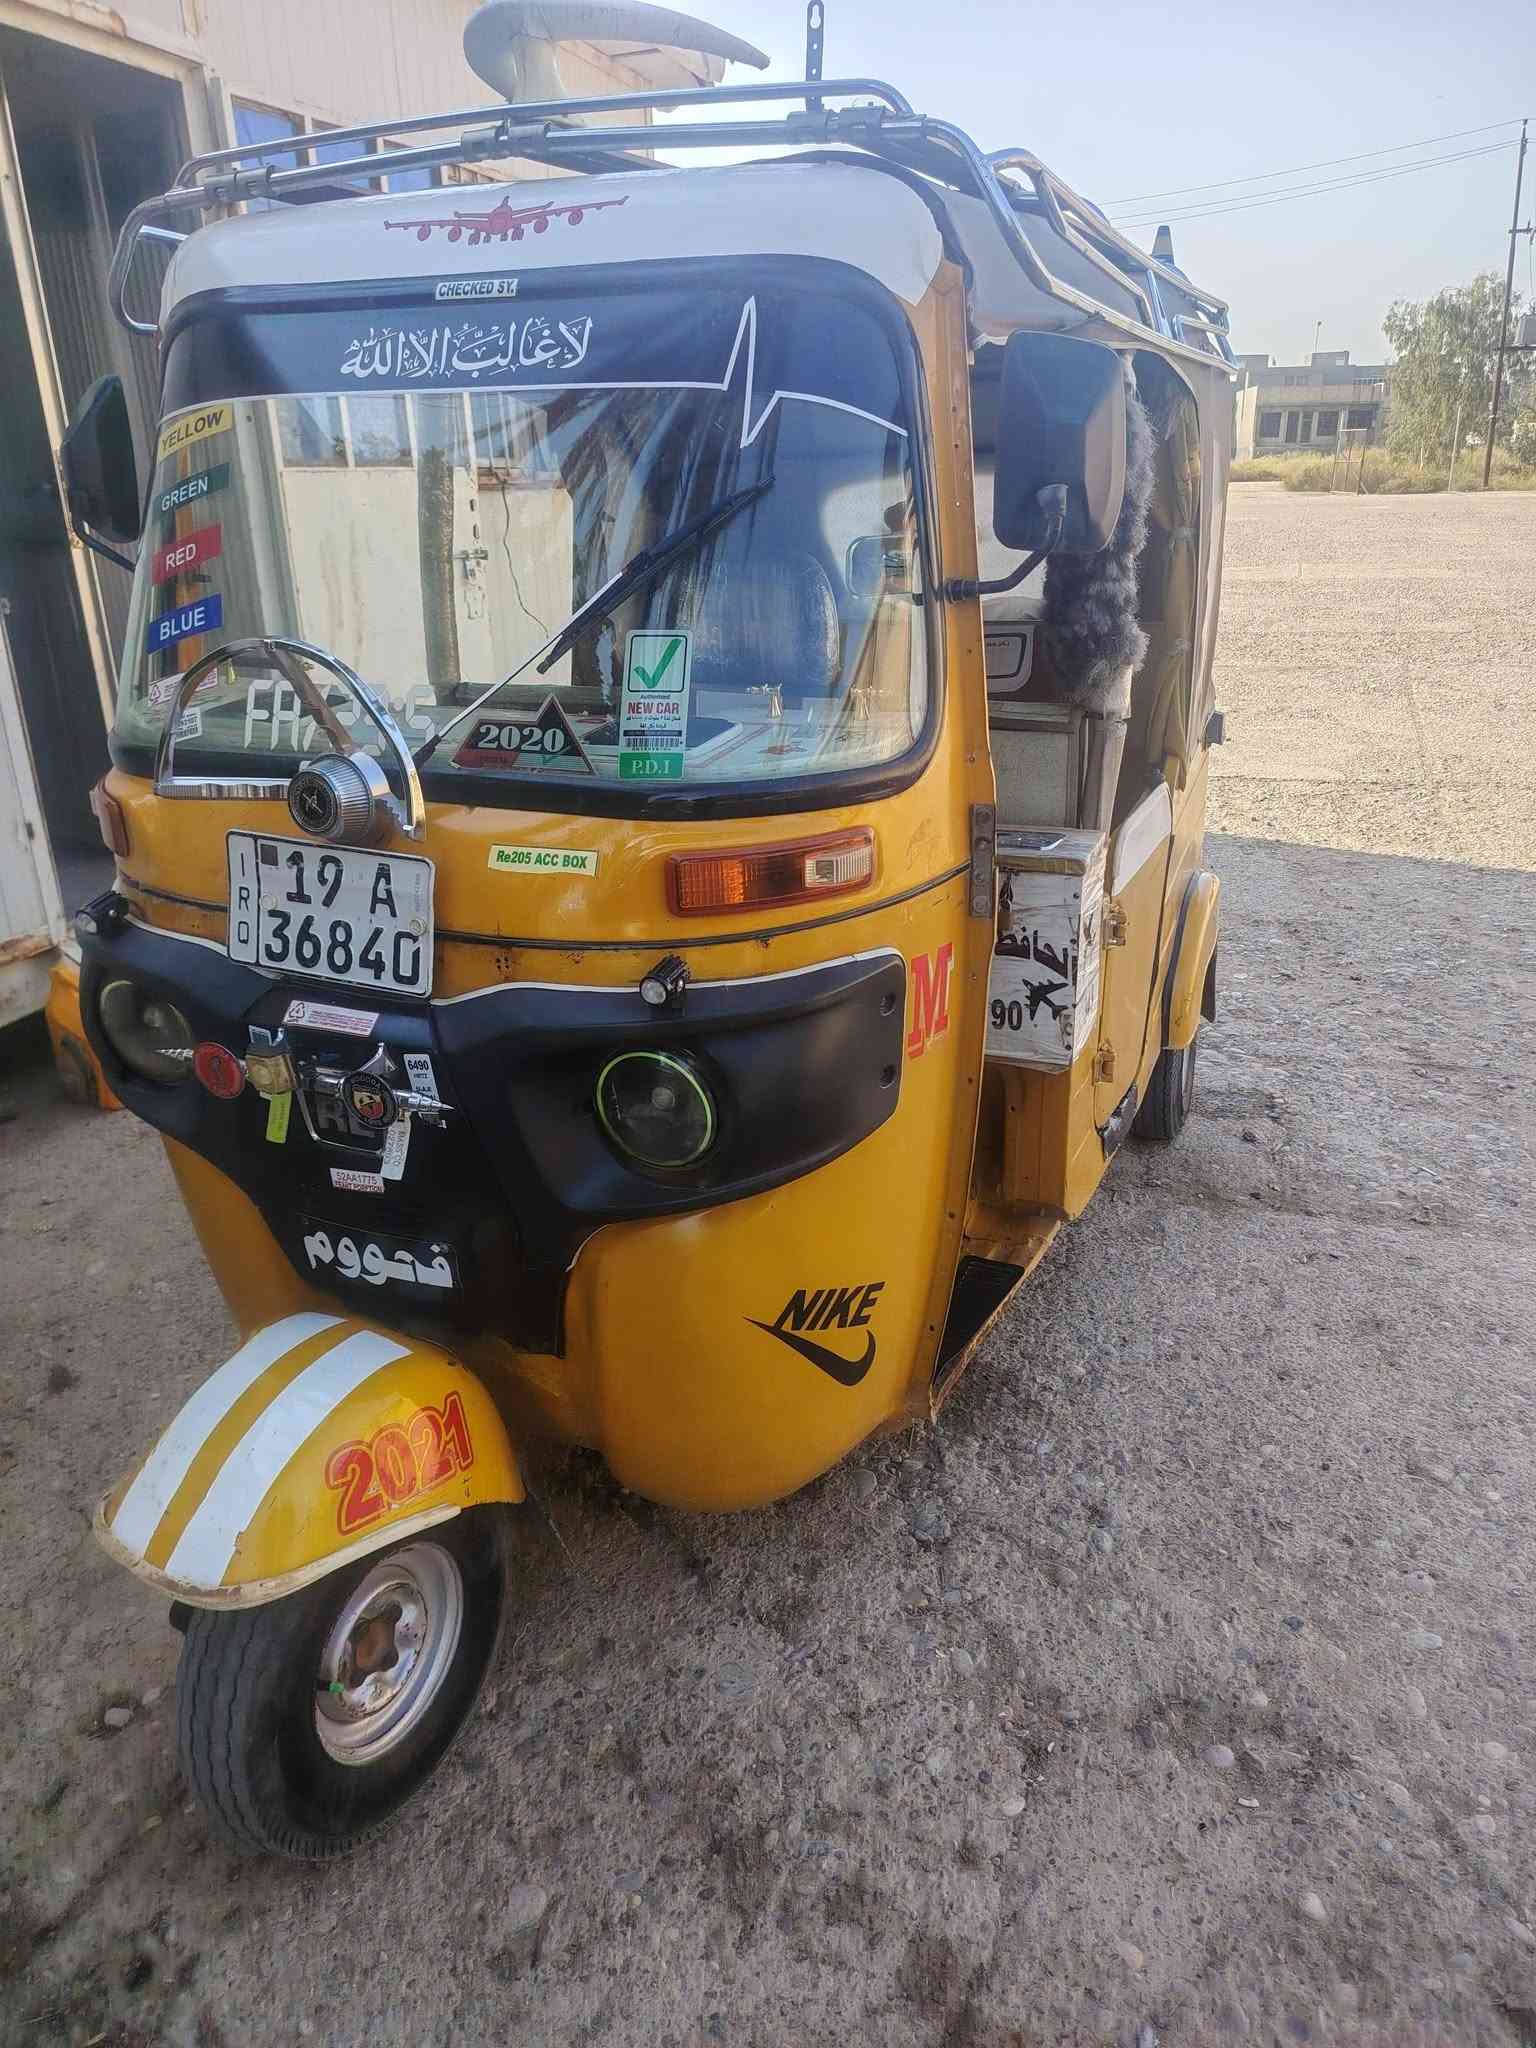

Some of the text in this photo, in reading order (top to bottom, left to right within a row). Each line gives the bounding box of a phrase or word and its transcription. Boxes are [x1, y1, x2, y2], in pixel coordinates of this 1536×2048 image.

[437, 283, 493, 300] CHECKED
[160, 409, 225, 454] YELLOW
[160, 476, 209, 512] GREEN
[165, 543, 197, 572] RED
[159, 606, 206, 641] BLUE
[627, 702, 680, 714] NEW CAR
[478, 724, 565, 753] 2020
[496, 850, 589, 869] Re205 ACC BOX
[286, 850, 344, 908] 19
[369, 862, 398, 918] A
[264, 909, 421, 986] 36840
[908, 942, 953, 1060] M
[990, 998, 1023, 1032] 90
[408, 1059, 429, 1071] 6490
[774, 1281, 885, 1331] NIKE
[325, 1390, 474, 1537] 2021
